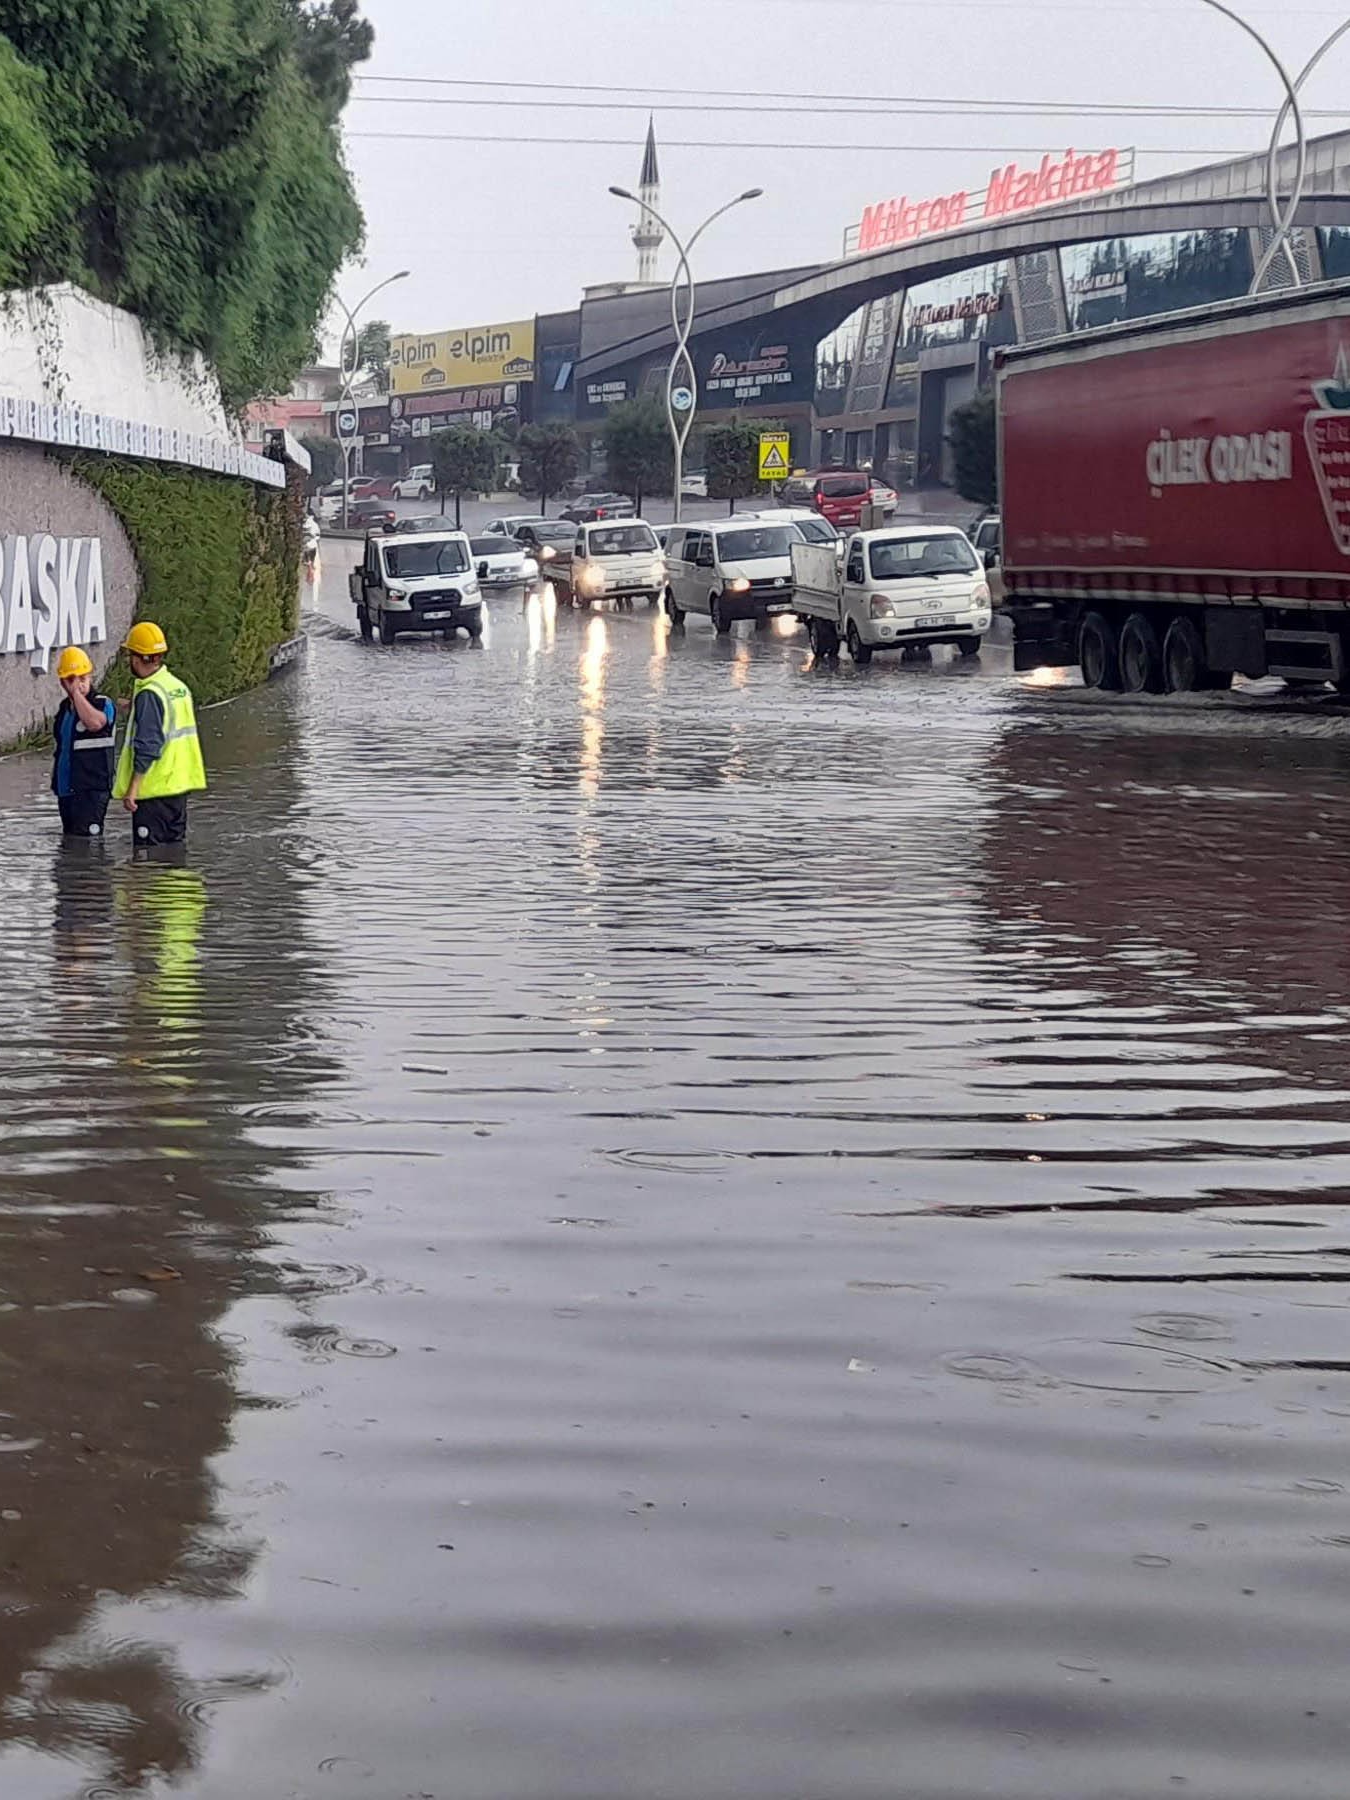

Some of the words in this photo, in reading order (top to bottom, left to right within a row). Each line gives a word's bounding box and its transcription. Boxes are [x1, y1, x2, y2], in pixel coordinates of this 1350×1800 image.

[858, 191, 968, 250] Mikron
[983, 147, 1118, 217] Makina
[390, 338, 436, 368] elpim
[450, 329, 510, 362] elpim
[1146, 427, 1210, 498] ÇİLEK
[1211, 431, 1292, 483] ODASI
